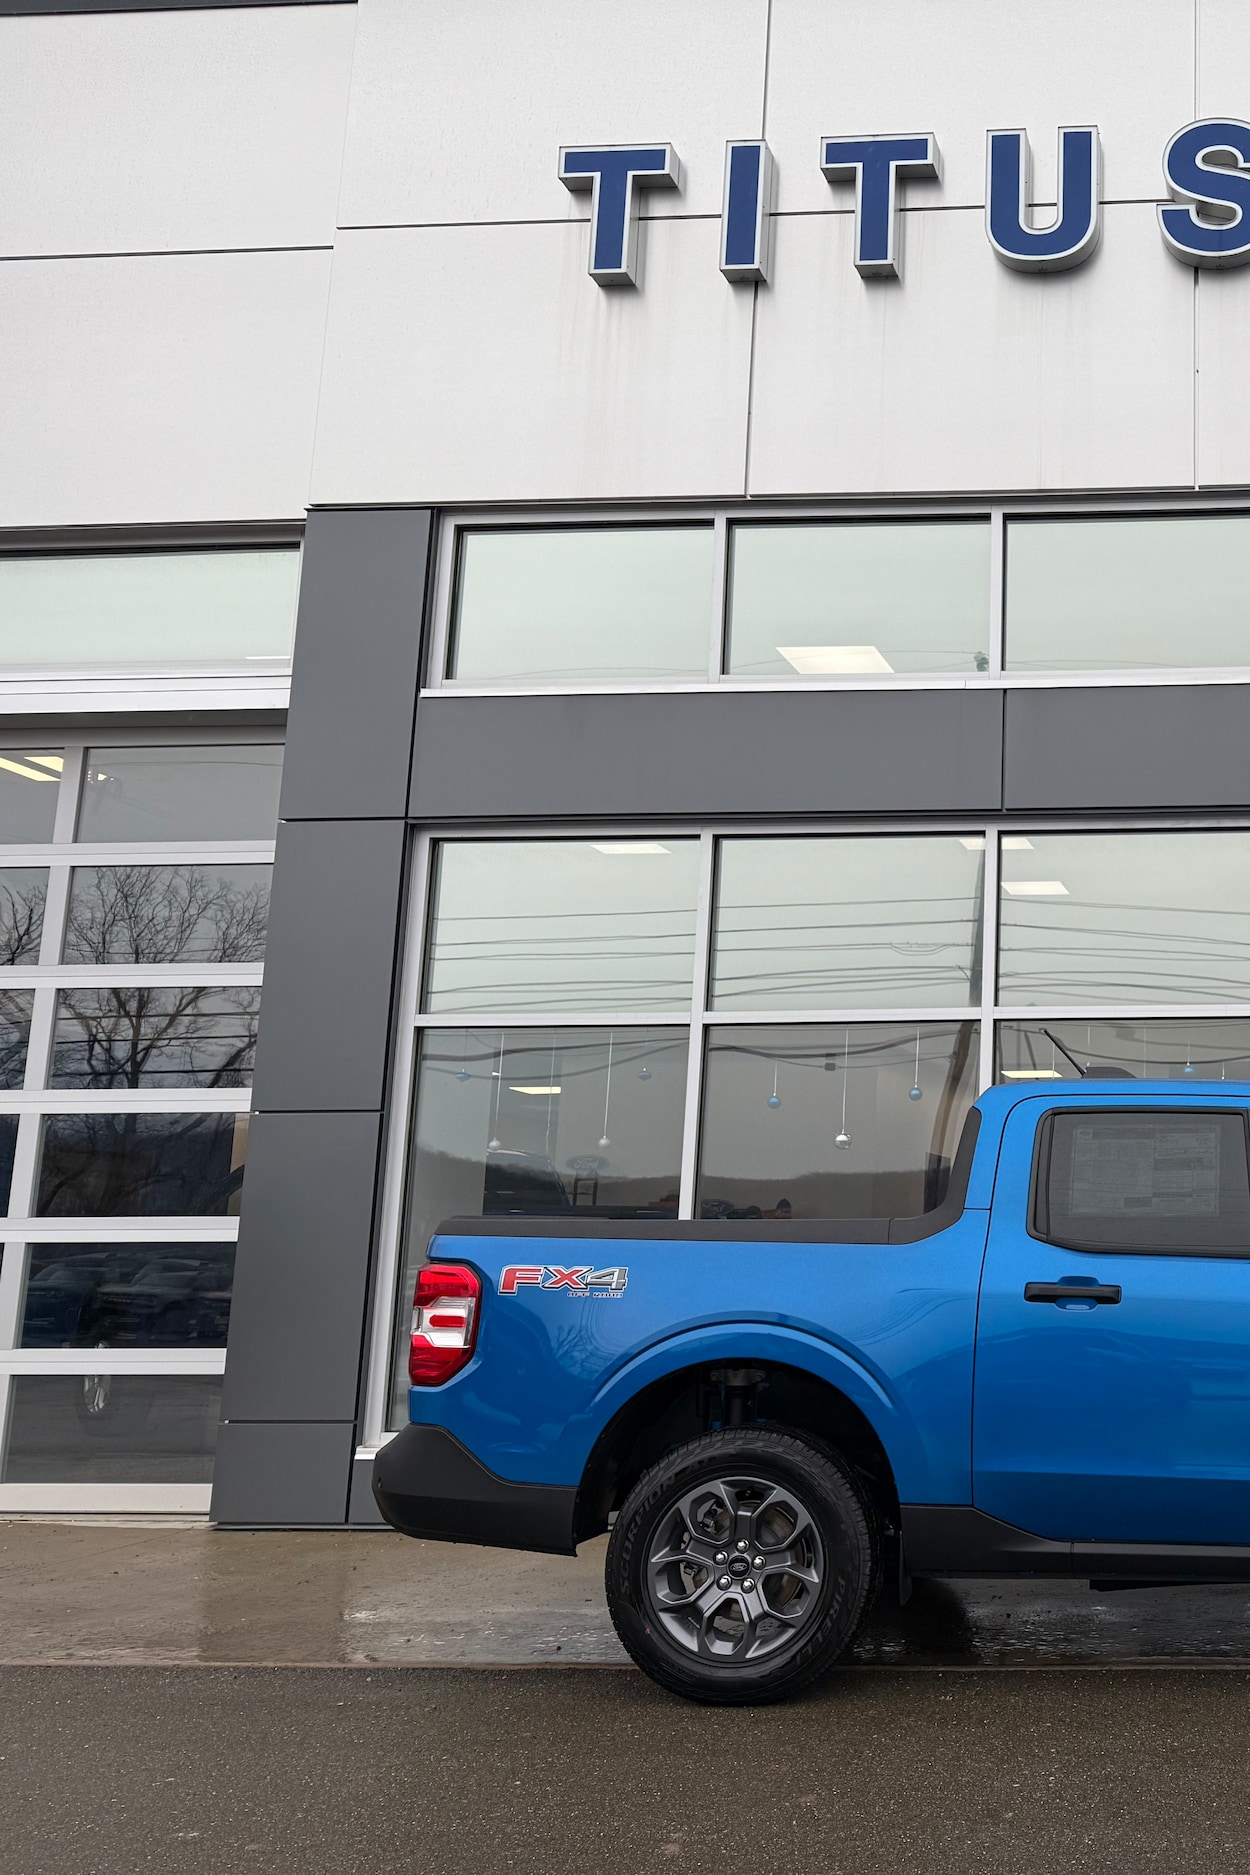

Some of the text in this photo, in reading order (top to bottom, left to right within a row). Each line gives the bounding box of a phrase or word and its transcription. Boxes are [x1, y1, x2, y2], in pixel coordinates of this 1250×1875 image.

[498, 1265, 628, 1295] FX4
[619, 1473, 677, 1595] SCORPION
[793, 1576, 846, 1666] PIRELLI
